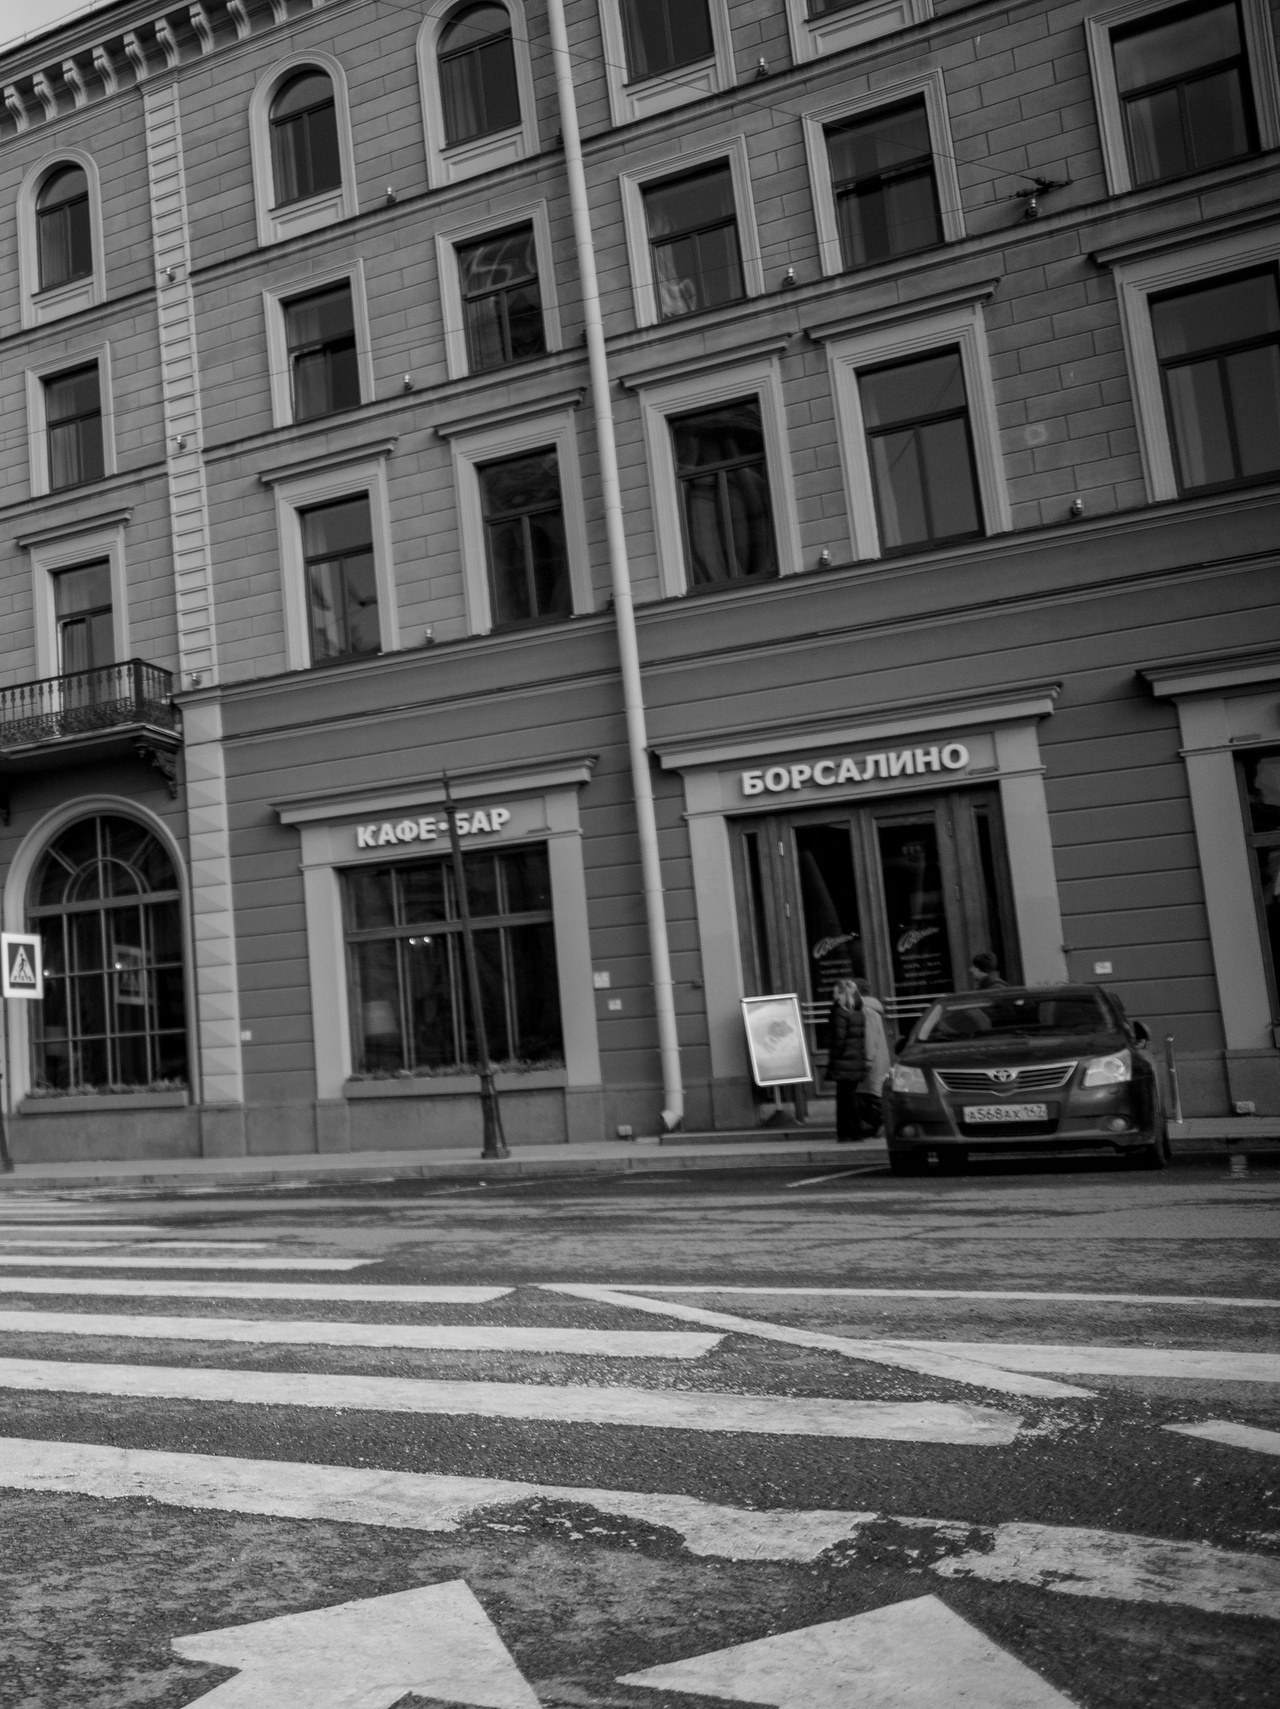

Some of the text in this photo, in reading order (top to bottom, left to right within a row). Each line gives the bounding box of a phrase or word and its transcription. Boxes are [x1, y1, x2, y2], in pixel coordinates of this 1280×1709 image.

[741, 743, 969, 795] БОРСАЛИНО
[356, 807, 511, 848] КАФЕ БАР
